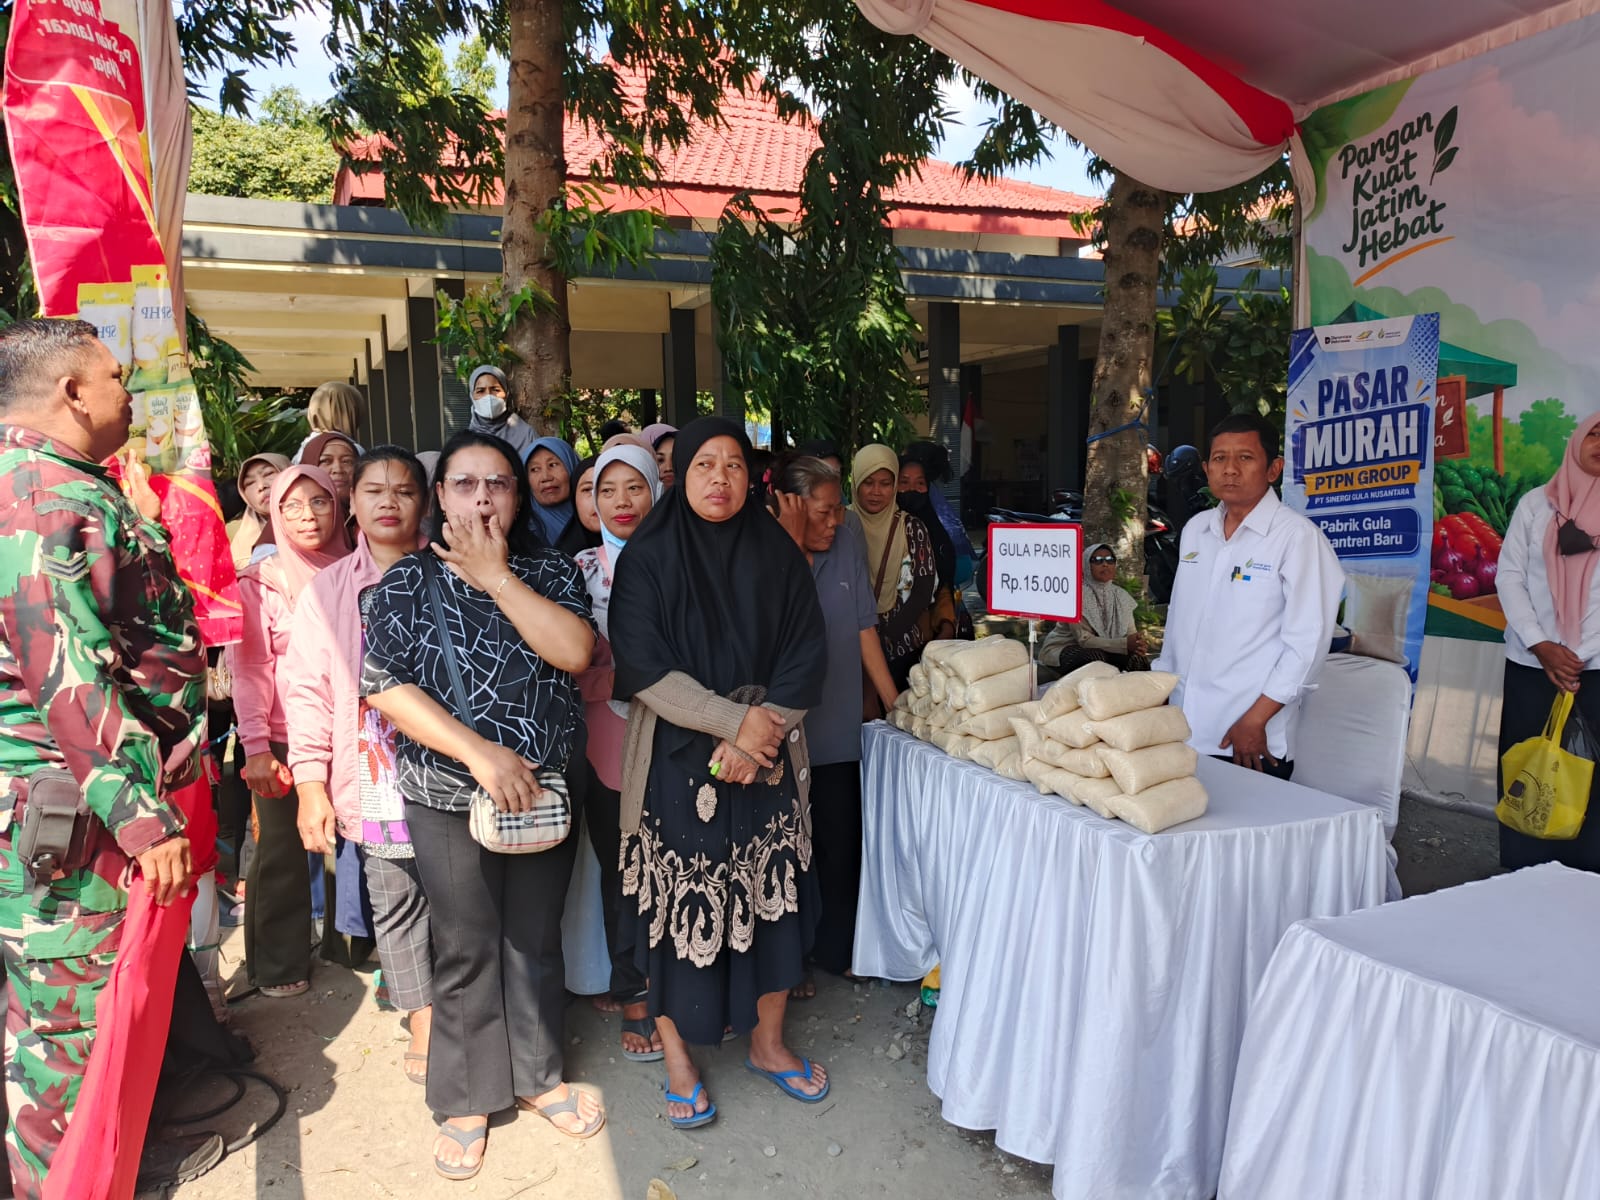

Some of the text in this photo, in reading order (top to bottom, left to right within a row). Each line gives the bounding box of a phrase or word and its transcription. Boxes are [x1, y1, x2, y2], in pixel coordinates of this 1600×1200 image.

[1337, 111, 1434, 179] Pangan
[1352, 149, 1418, 206] Kuat
[1358, 199, 1446, 268] Hebat
[1318, 365, 1409, 417] PASAR
[1304, 409, 1419, 470] MURAH
[1315, 465, 1411, 490] PTPN GROUP
[1315, 488, 1410, 505] PT SINERGI GULA NUSANTARA
[1320, 516, 1391, 533] Pabrik Gula
[998, 542, 1071, 559] GULA PASIR
[1329, 532, 1403, 549] antren Baru
[1001, 573, 1069, 594] Rp.15.000
